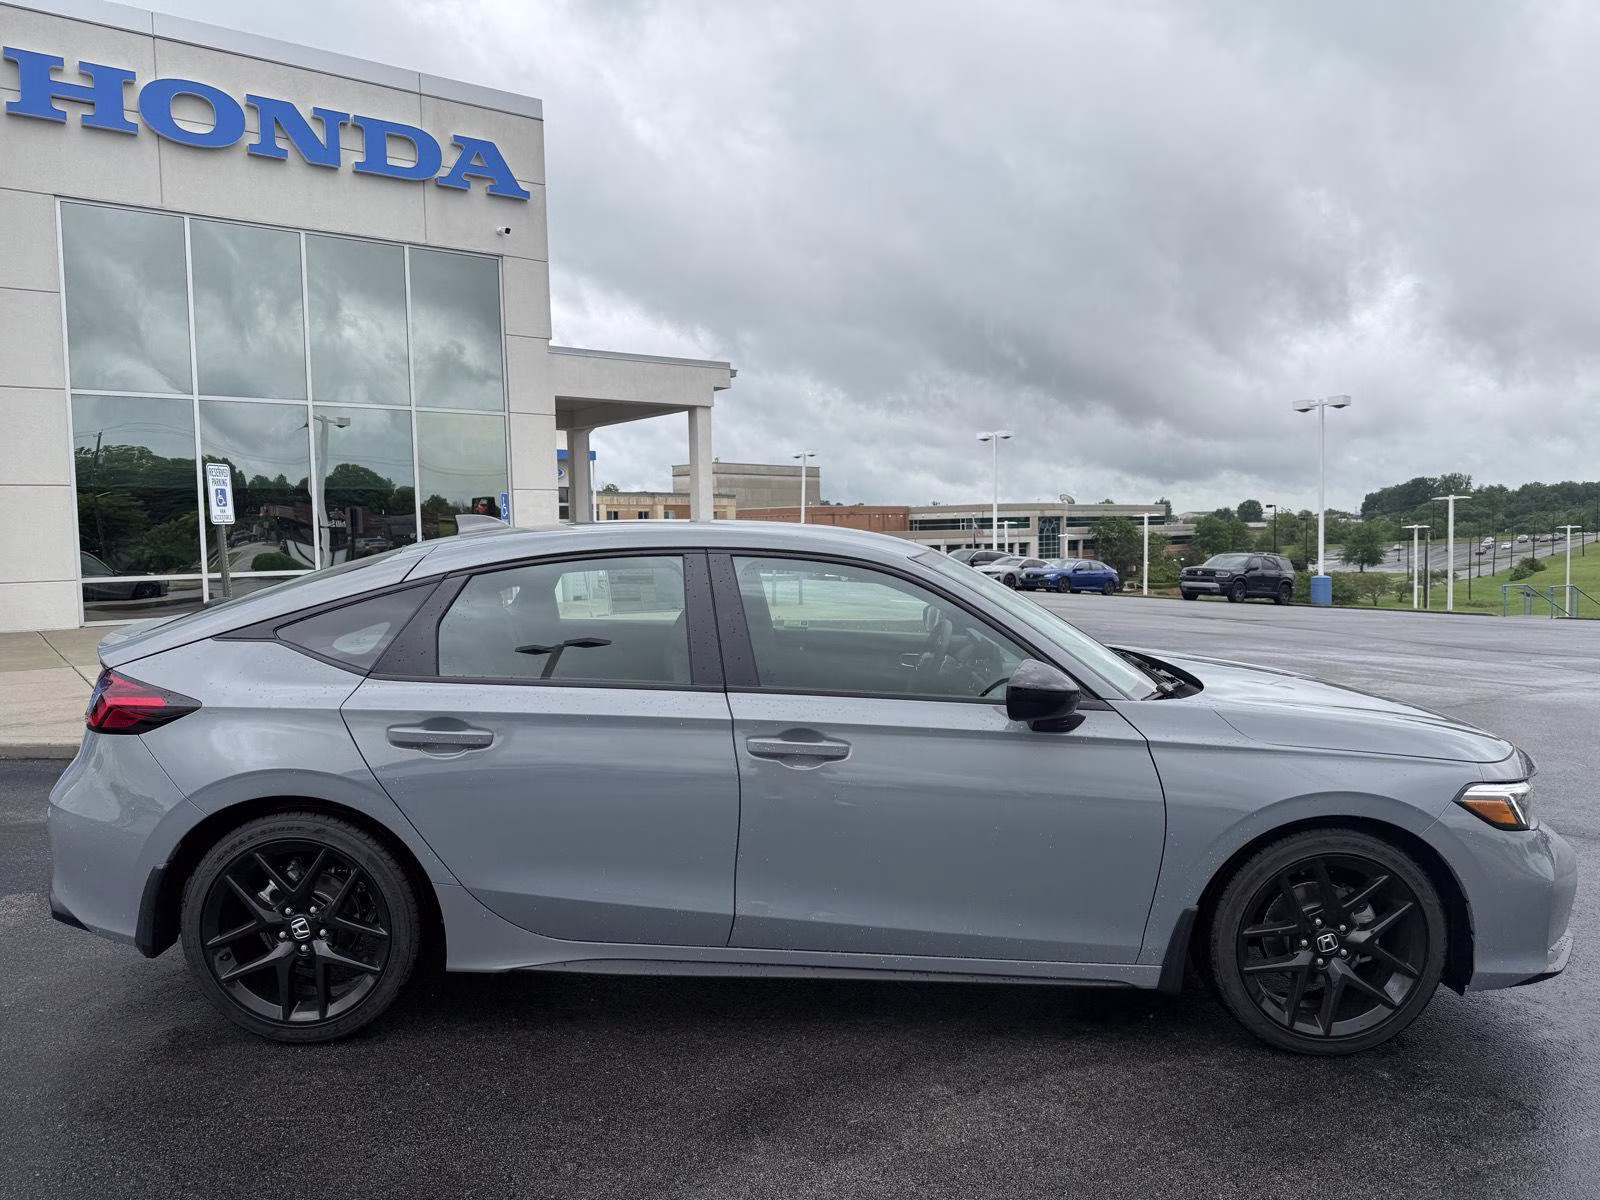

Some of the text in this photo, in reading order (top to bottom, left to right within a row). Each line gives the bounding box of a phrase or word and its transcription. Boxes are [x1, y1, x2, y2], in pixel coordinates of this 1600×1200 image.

[3, 46, 531, 201] HONDA
[209, 467, 229, 477] RESERVED
[211, 478, 228, 487] PARKING
